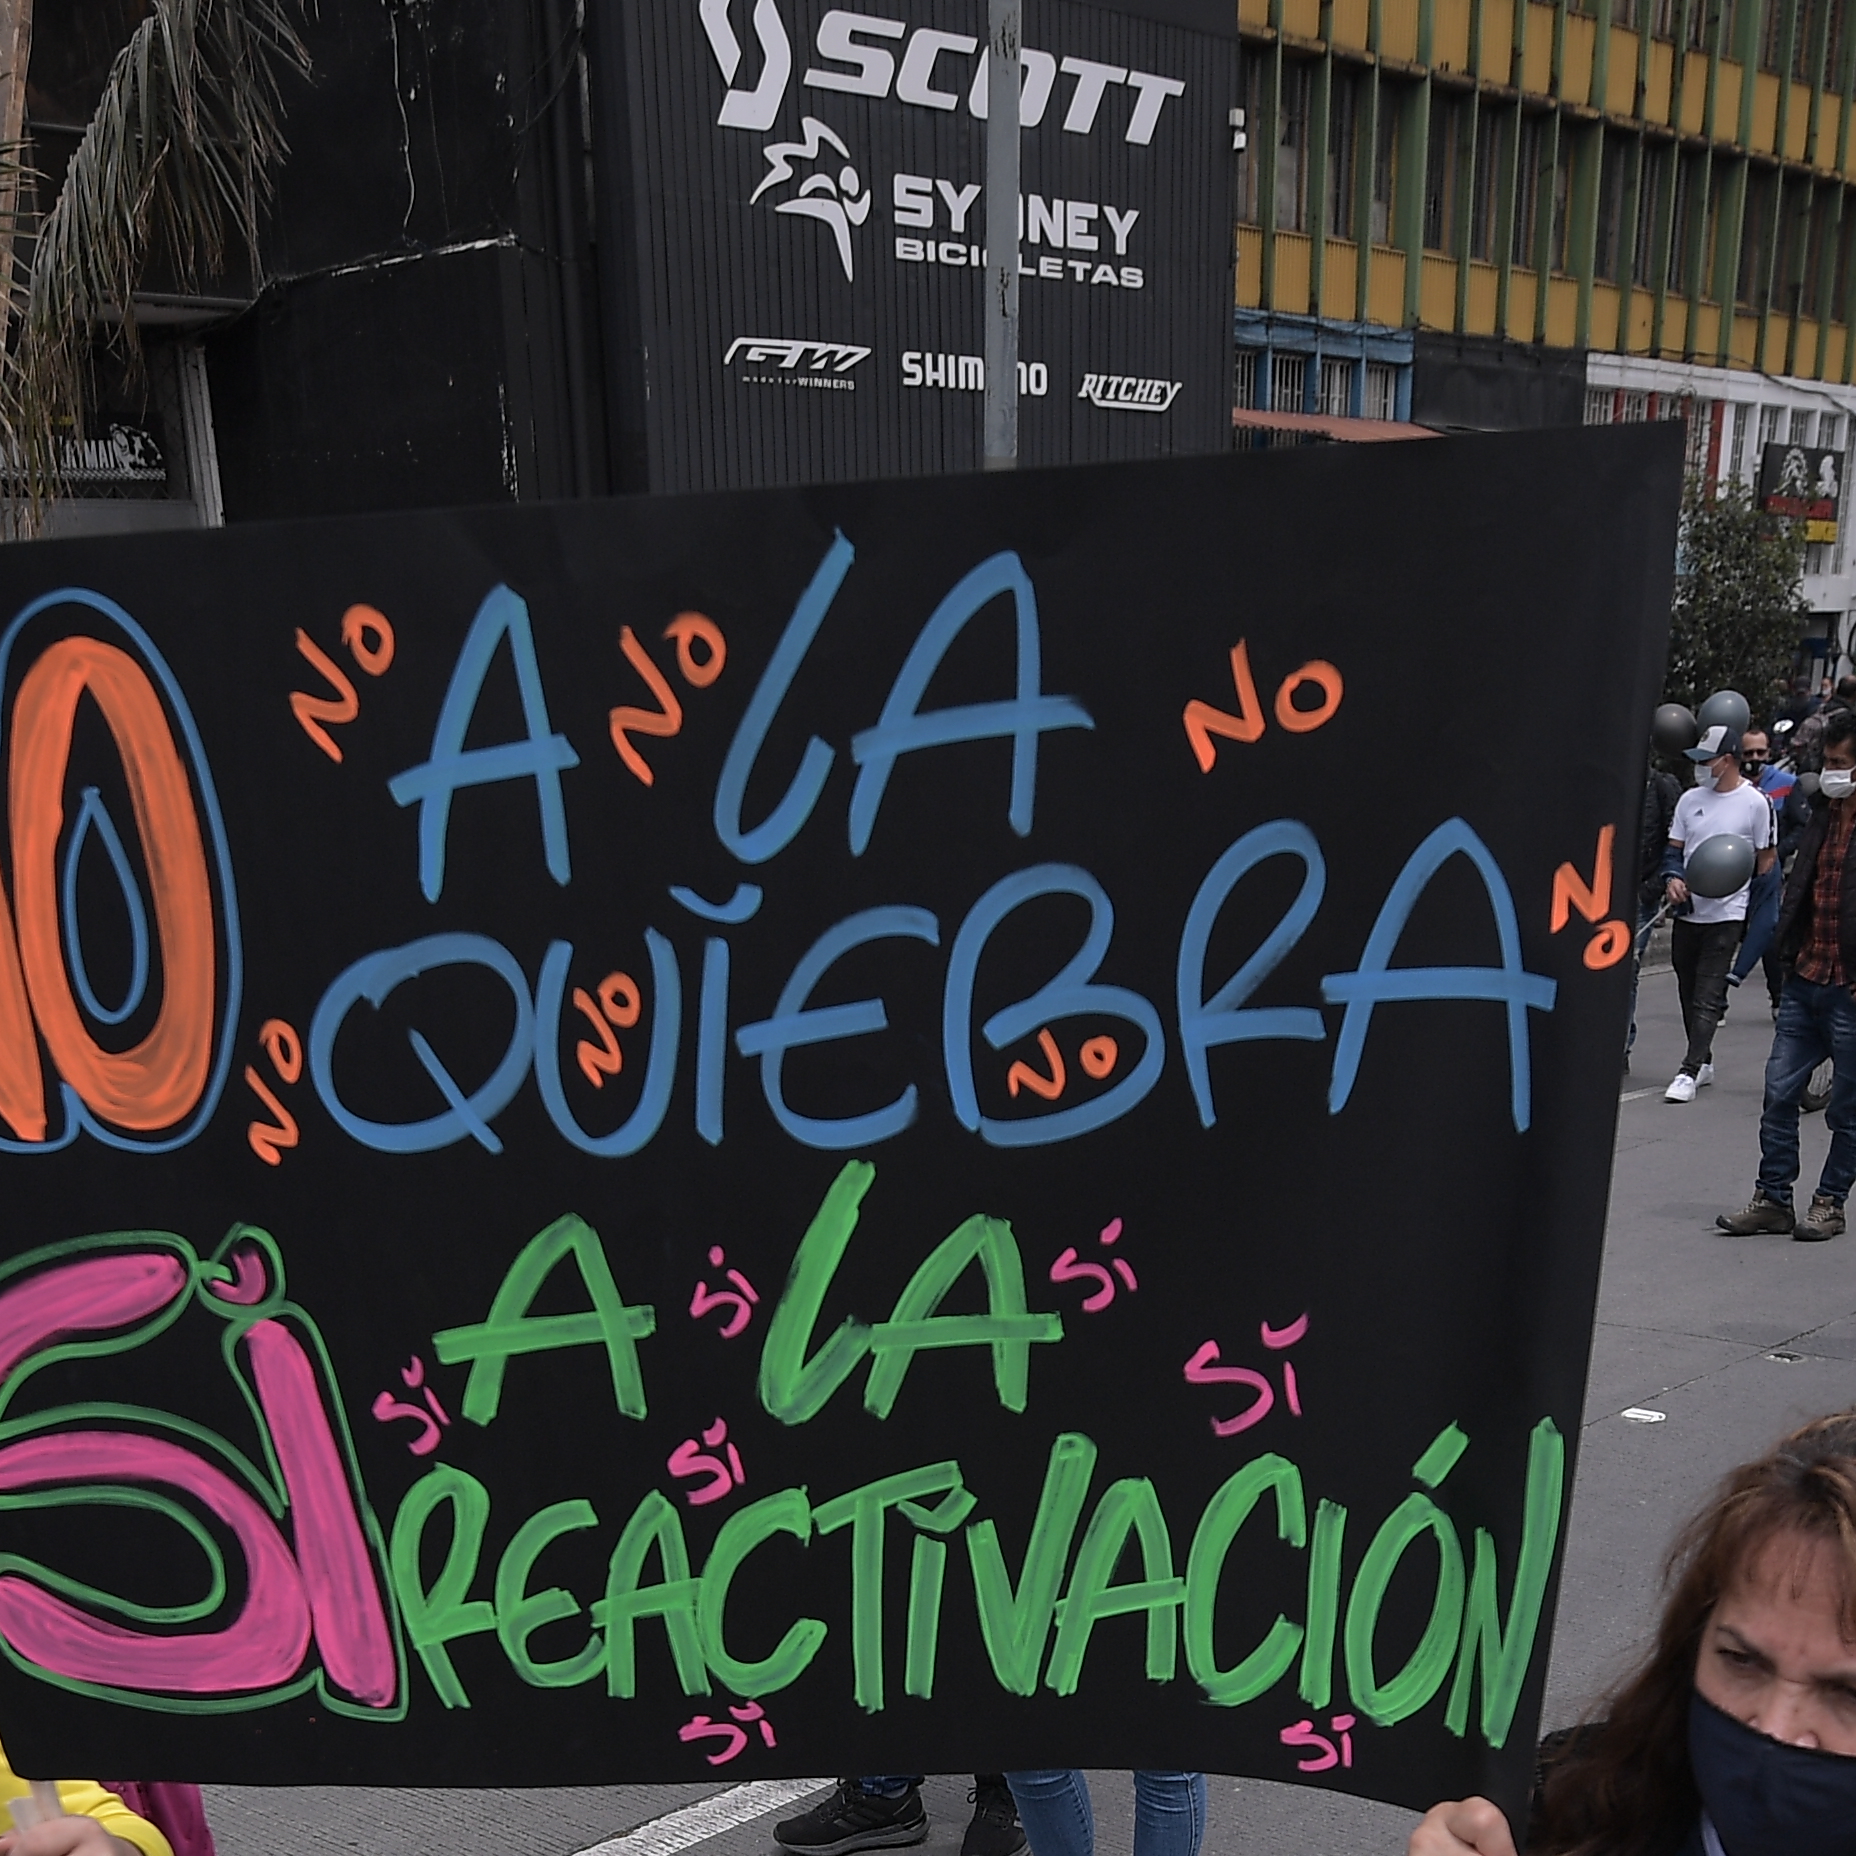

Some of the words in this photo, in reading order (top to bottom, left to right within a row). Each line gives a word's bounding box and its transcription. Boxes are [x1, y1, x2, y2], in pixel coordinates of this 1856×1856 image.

[803, 9, 1185, 145] SCOTT
[894, 173, 1139, 255] SYNEY
[895, 237, 1144, 289] BICILETAS
[798, 377, 855, 390] WINNERS
[902, 352, 1048, 396] SHIMNO
[1078, 373, 1182, 406] RITCHEY
[291, 604, 395, 763] NO
[388, 583, 580, 903] A
[704, 520, 1095, 864] LA
[609, 610, 727, 786] NO
[1183, 638, 1343, 773] NO
[1551, 825, 1630, 969] NO
[308, 817, 1557, 1157] QUIEBRA
[573, 973, 641, 1088] NO
[246, 1019, 302, 1166] NO
[1008, 1029, 1118, 1099] NO
[432, 1213, 656, 1427] A
[757, 1159, 1065, 1427] LA
